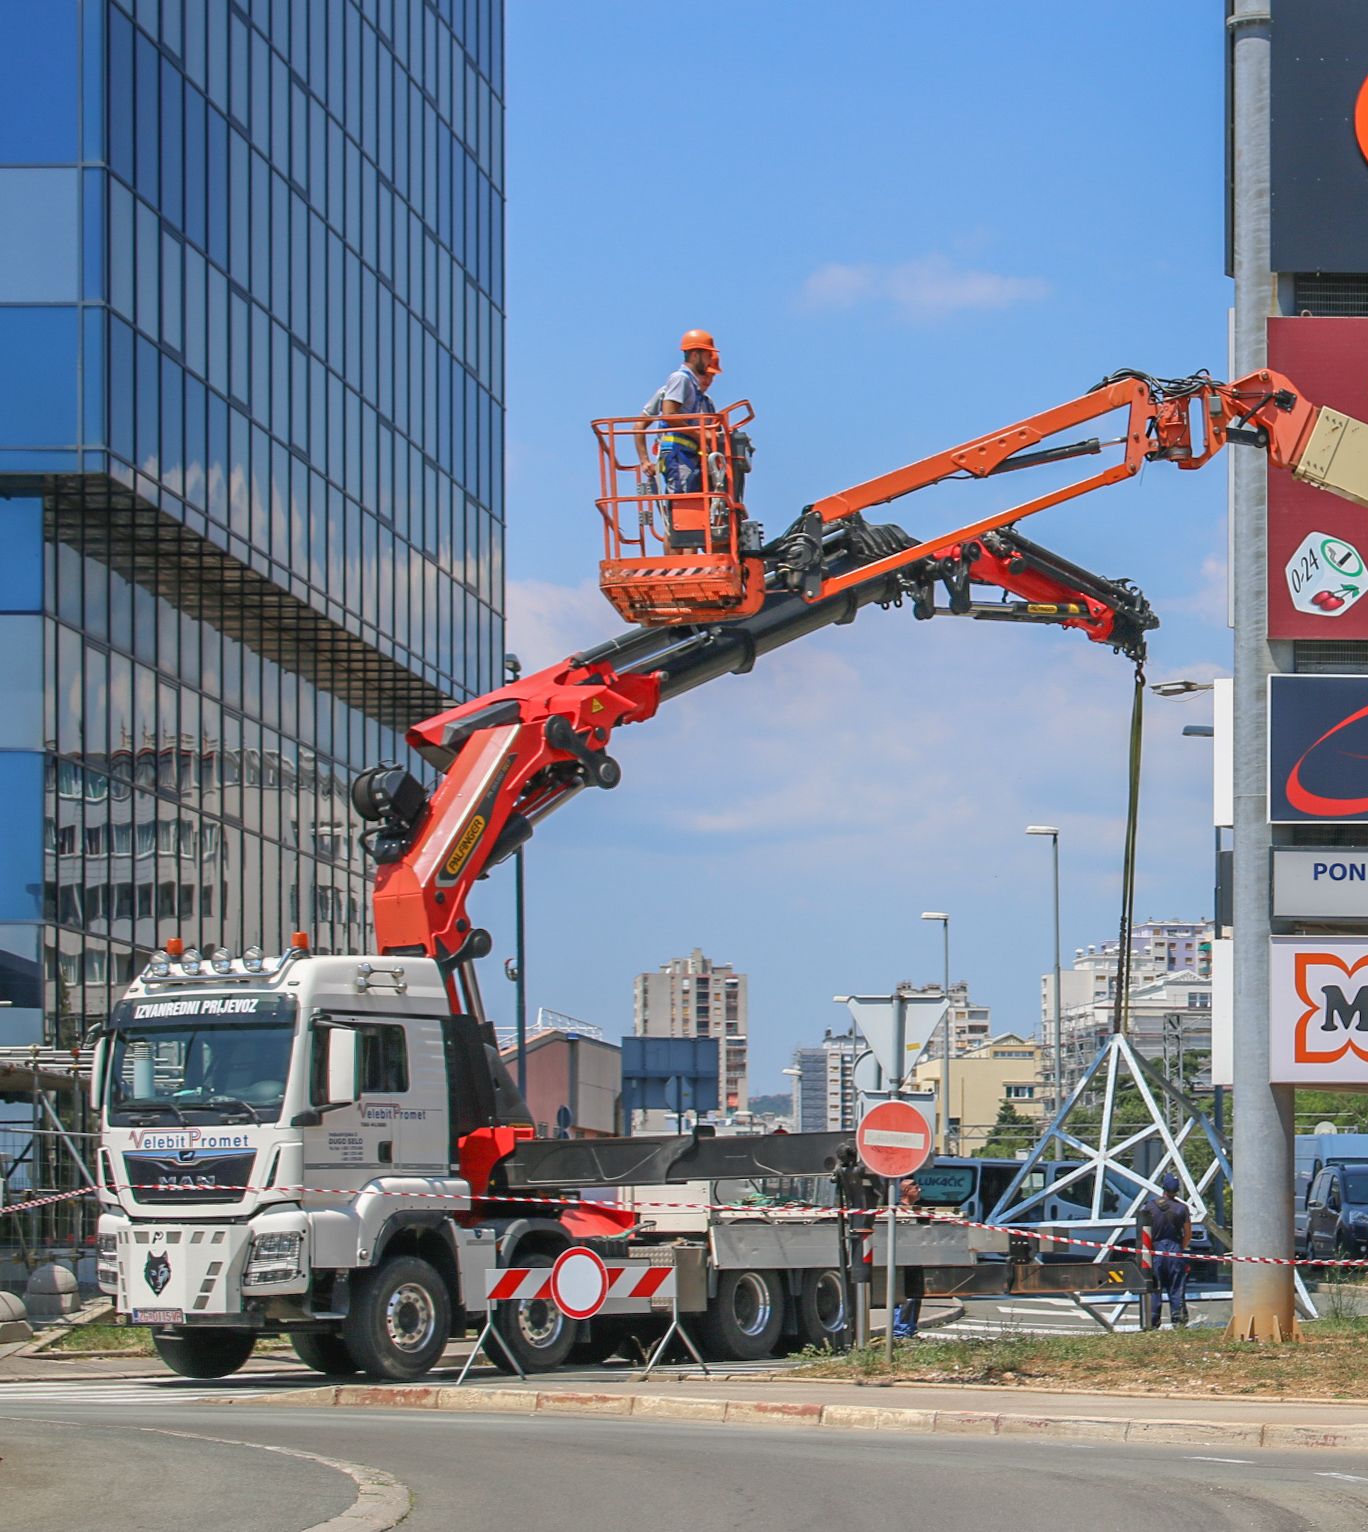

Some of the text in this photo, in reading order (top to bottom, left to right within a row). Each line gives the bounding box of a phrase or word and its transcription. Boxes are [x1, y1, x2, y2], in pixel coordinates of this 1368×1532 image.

[1291, 548, 1319, 593] 0-24
[134, 999, 259, 1019] IZVANREDNI PRIJEVOZ
[358, 1102, 426, 1120] Velebit Promet
[128, 1129, 249, 1149] Velebit Promet
[158, 1175, 216, 1191] MAN
